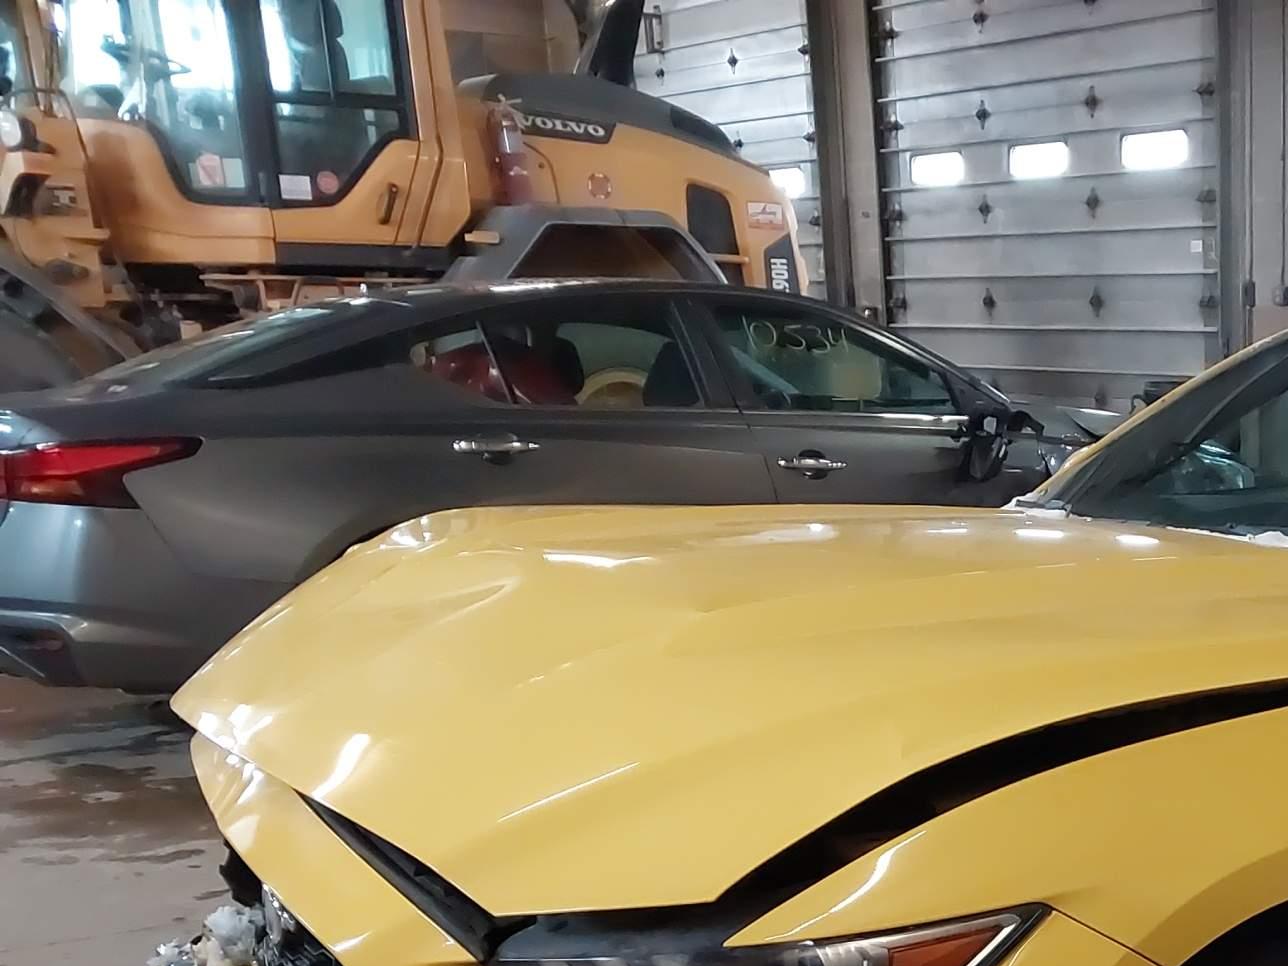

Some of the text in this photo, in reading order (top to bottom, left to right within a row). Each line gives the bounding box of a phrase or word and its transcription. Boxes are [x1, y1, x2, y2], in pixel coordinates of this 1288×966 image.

[520, 113, 606, 138] VOLVO
[769, 258, 790, 293] 90H
[742, 315, 850, 354] 10534
